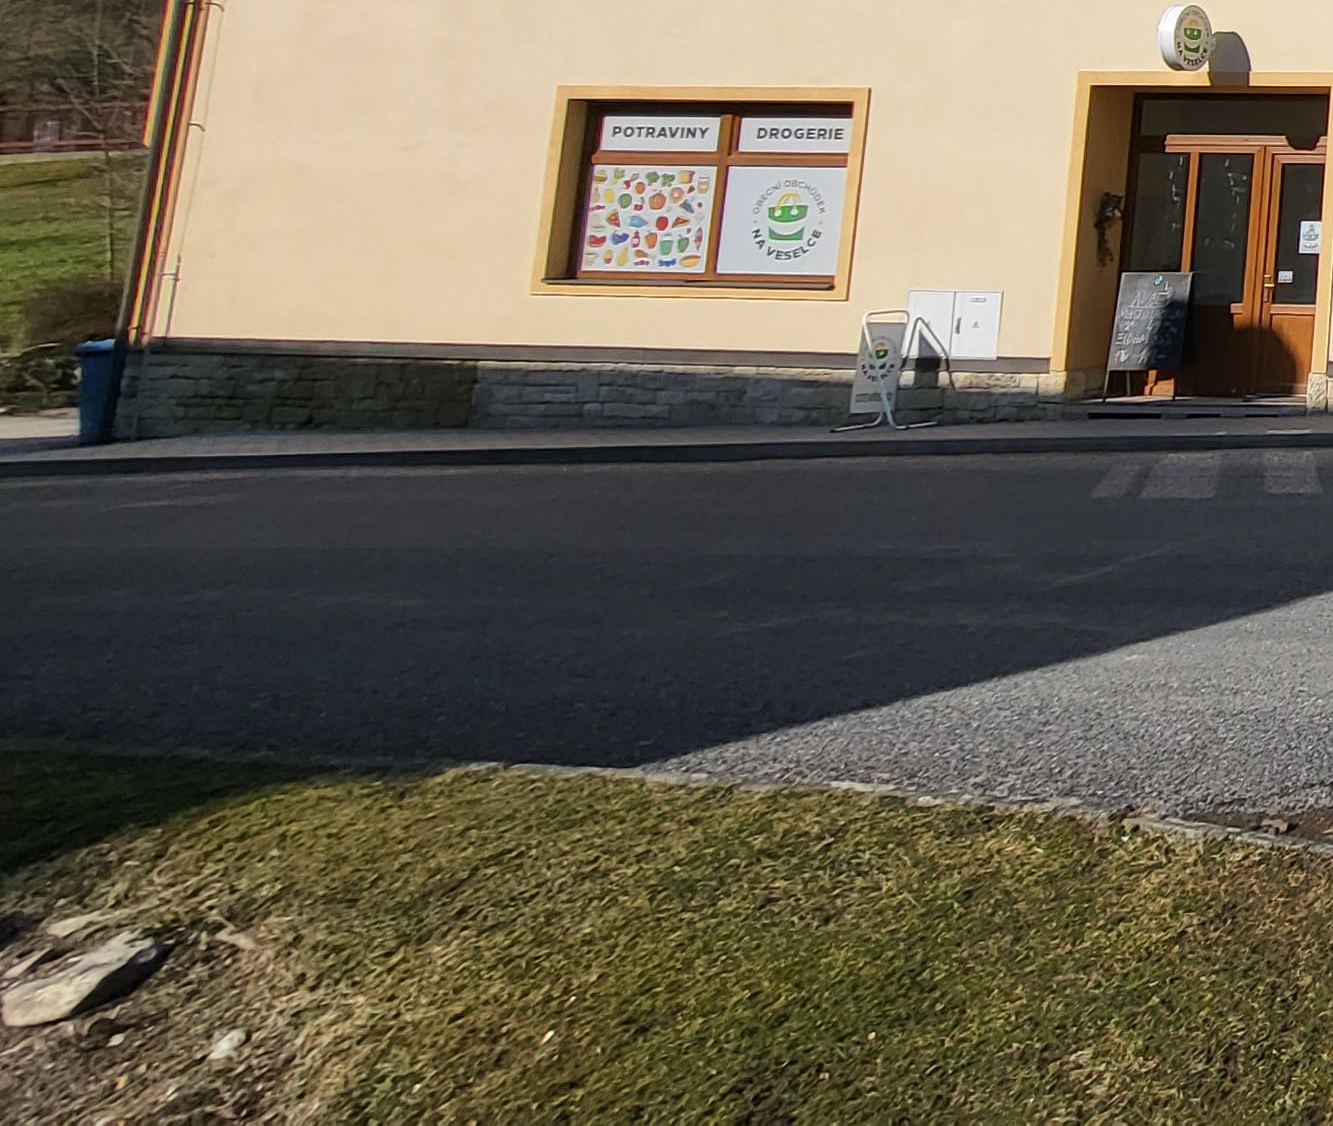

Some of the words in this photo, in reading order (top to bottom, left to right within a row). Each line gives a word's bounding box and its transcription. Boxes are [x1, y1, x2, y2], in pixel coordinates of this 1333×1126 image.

[611, 126, 710, 139] POTRAVINY
[756, 127, 845, 140] DROGERIE
[752, 228, 766, 250] NA
[766, 229, 822, 260] VESELCE
